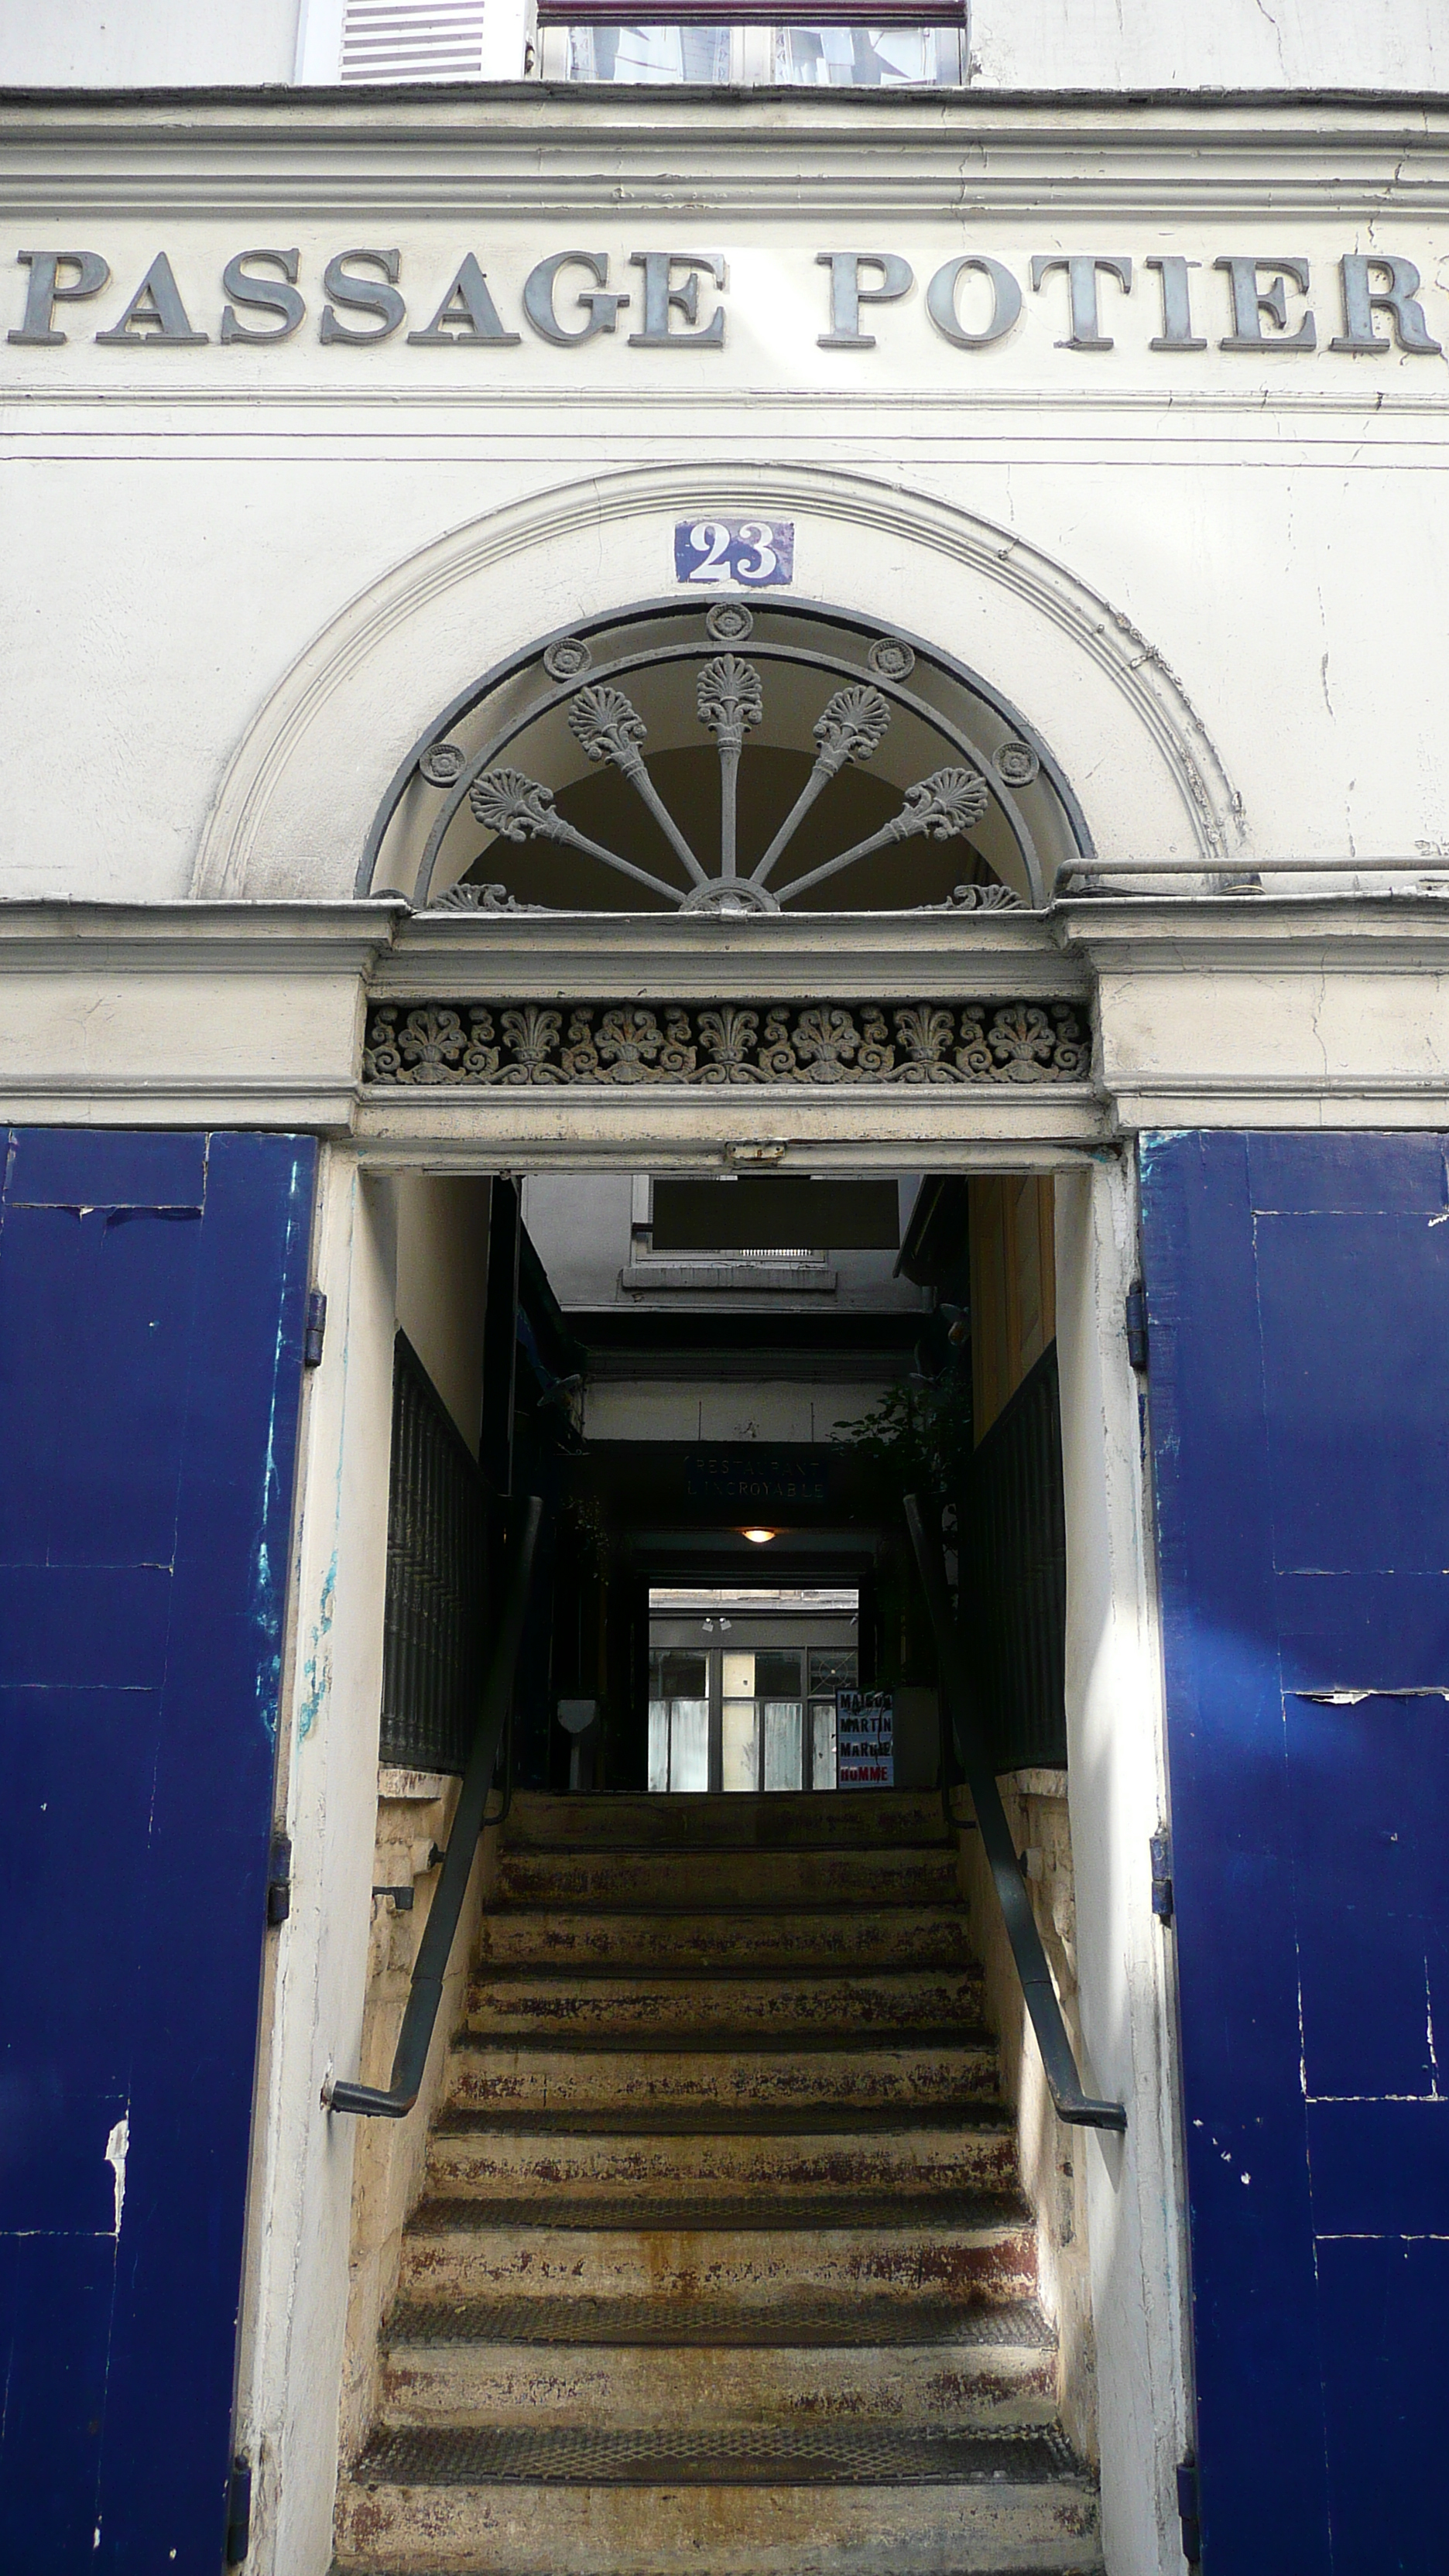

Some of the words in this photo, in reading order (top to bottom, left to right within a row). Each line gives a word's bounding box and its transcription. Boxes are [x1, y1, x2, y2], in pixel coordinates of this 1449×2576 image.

[7, 248, 728, 347] PASSAGE
[814, 252, 1443, 355] POTIER
[690, 522, 777, 579] 23
[697, 1459, 820, 1475] RESTAURANT
[687, 1480, 824, 1498] LINCROYABLE
[841, 1718, 891, 1732] MARTIN
[841, 1766, 888, 1781] HOMME
